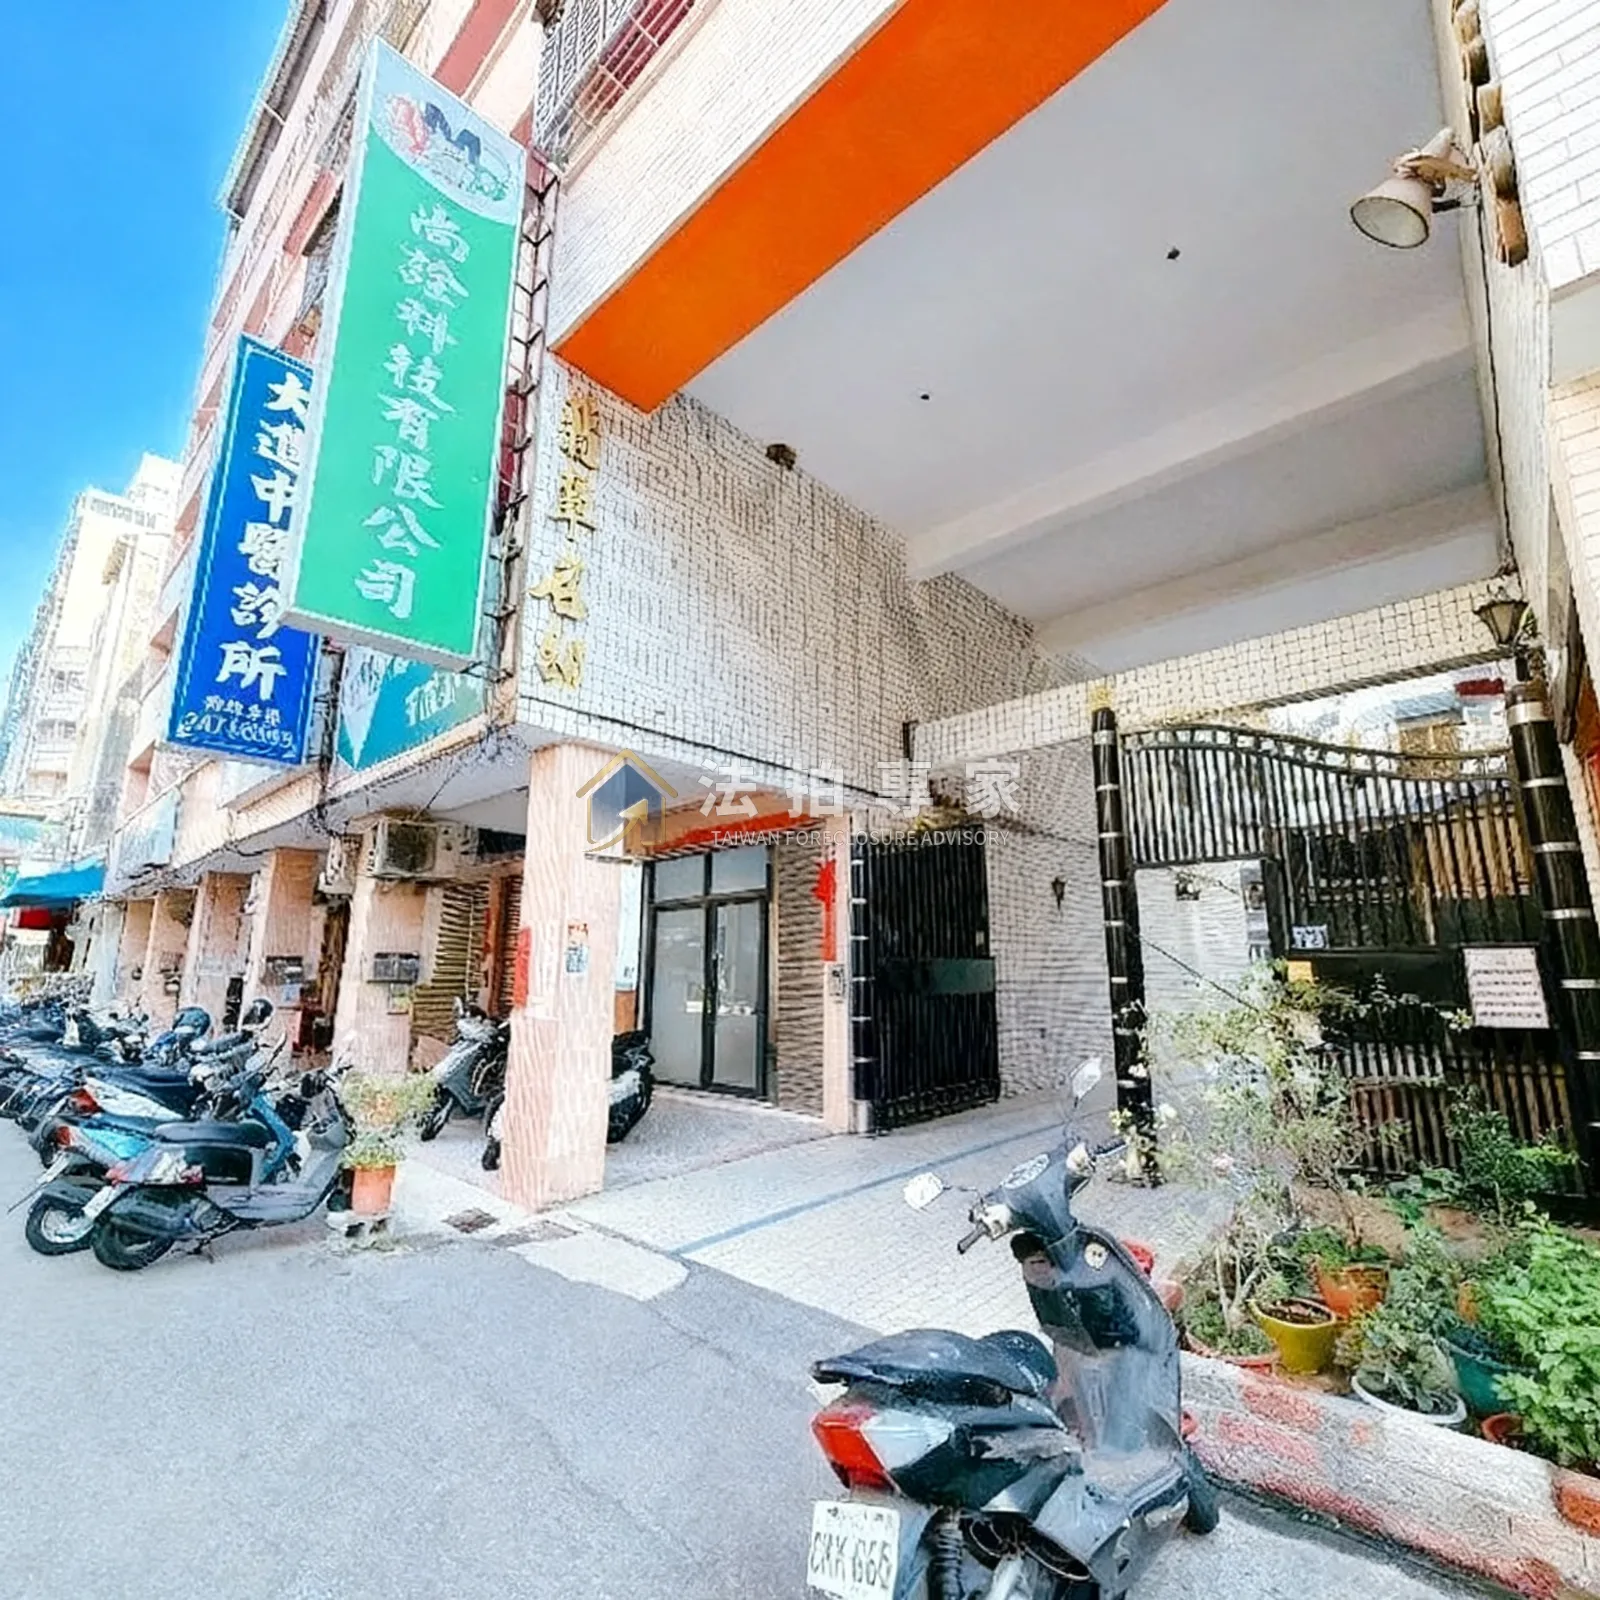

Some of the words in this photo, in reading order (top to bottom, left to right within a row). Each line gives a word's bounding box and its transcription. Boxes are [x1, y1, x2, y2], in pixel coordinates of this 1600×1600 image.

[215, 371, 310, 700] 大道中醫診所
